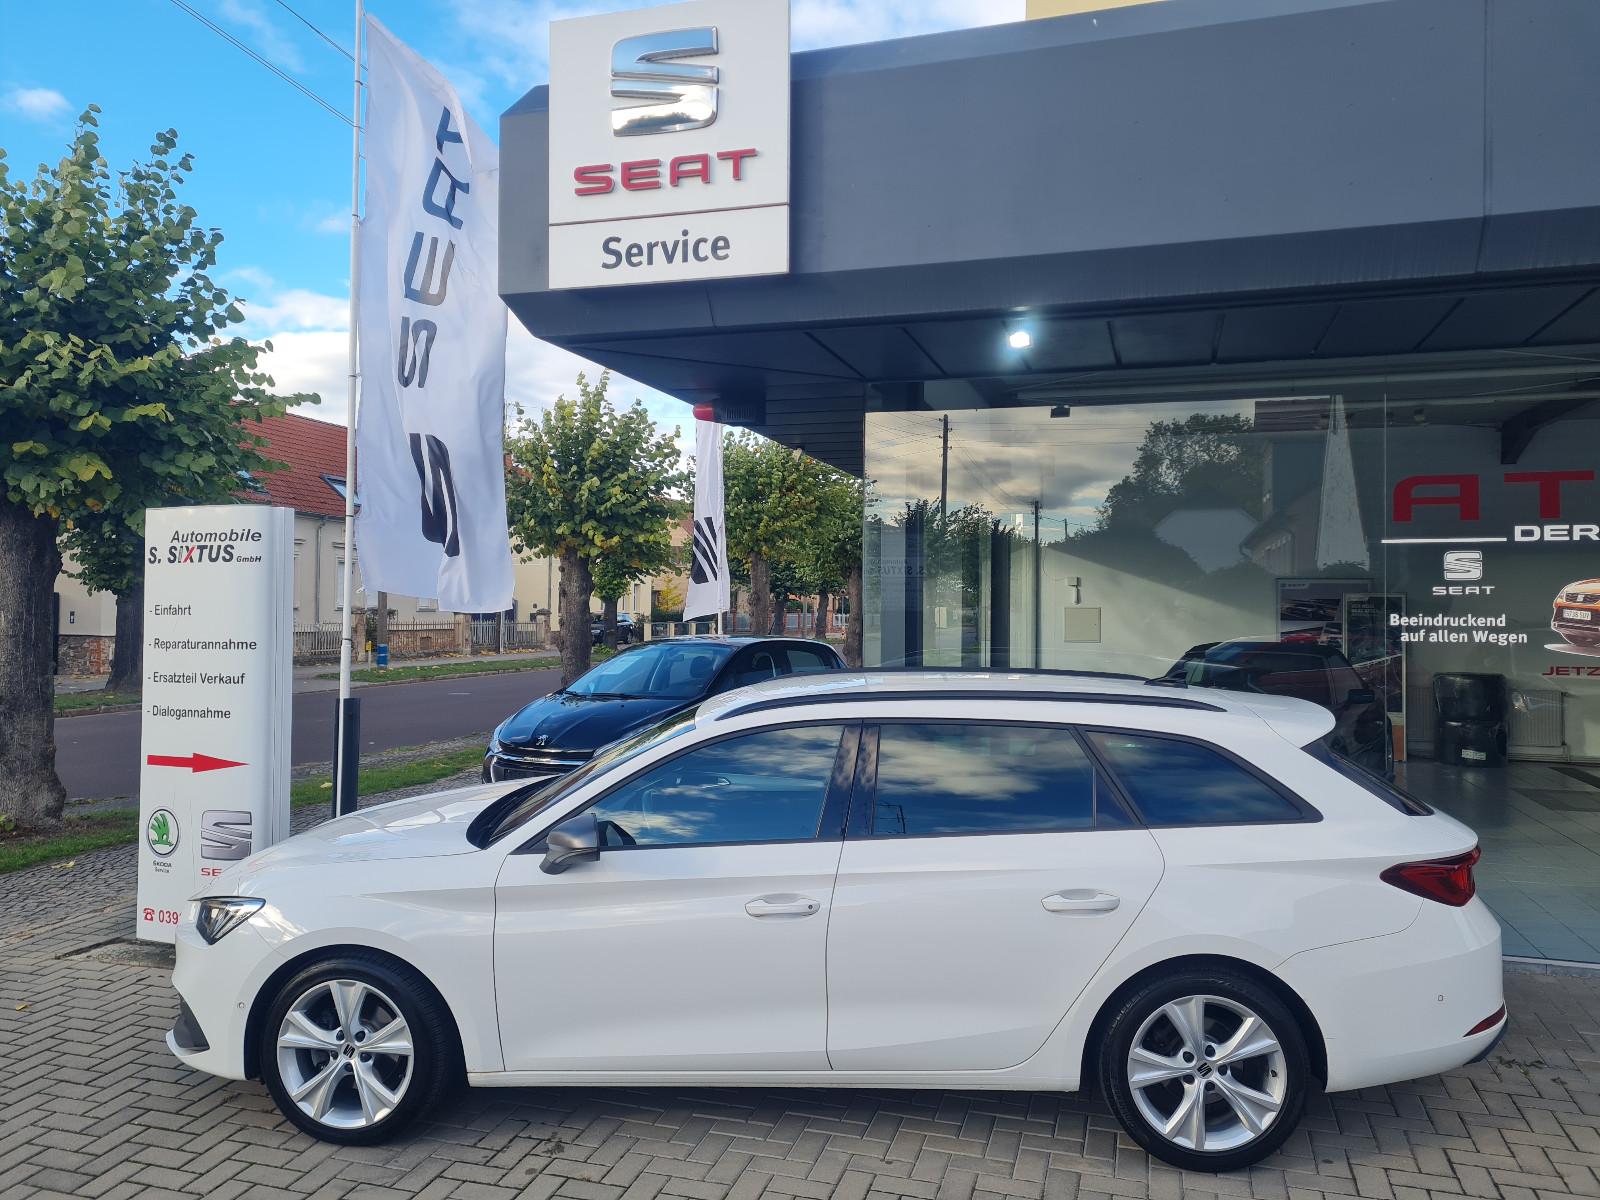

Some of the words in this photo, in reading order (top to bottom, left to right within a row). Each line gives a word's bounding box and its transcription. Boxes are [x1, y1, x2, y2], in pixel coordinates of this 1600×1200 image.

[573, 148, 758, 196] SEAT
[398, 105, 470, 388] SEAT
[601, 229, 730, 269] Service
[170, 529, 262, 543] Automobile
[1514, 524, 1600, 542] DER
[148, 546, 162, 564] S.
[167, 544, 235, 564] SIXTUS
[236, 555, 262, 563] GmbH
[1432, 586, 1495, 596] SEAT
[154, 604, 192, 616] Einfahrt
[1390, 613, 1506, 627] Beeindruckend
[1400, 629, 1426, 643] auf
[1429, 629, 1468, 643] allen
[1473, 631, 1528, 646] Wegen
[153, 638, 257, 652] Reparaturannahme
[153, 671, 197, 684] Ersatzteil
[200, 672, 245, 685] Verkauf
[1541, 666, 1600, 676] JETZ
[152, 705, 231, 720] Dialogannahme
[159, 910, 182, 924] 039
